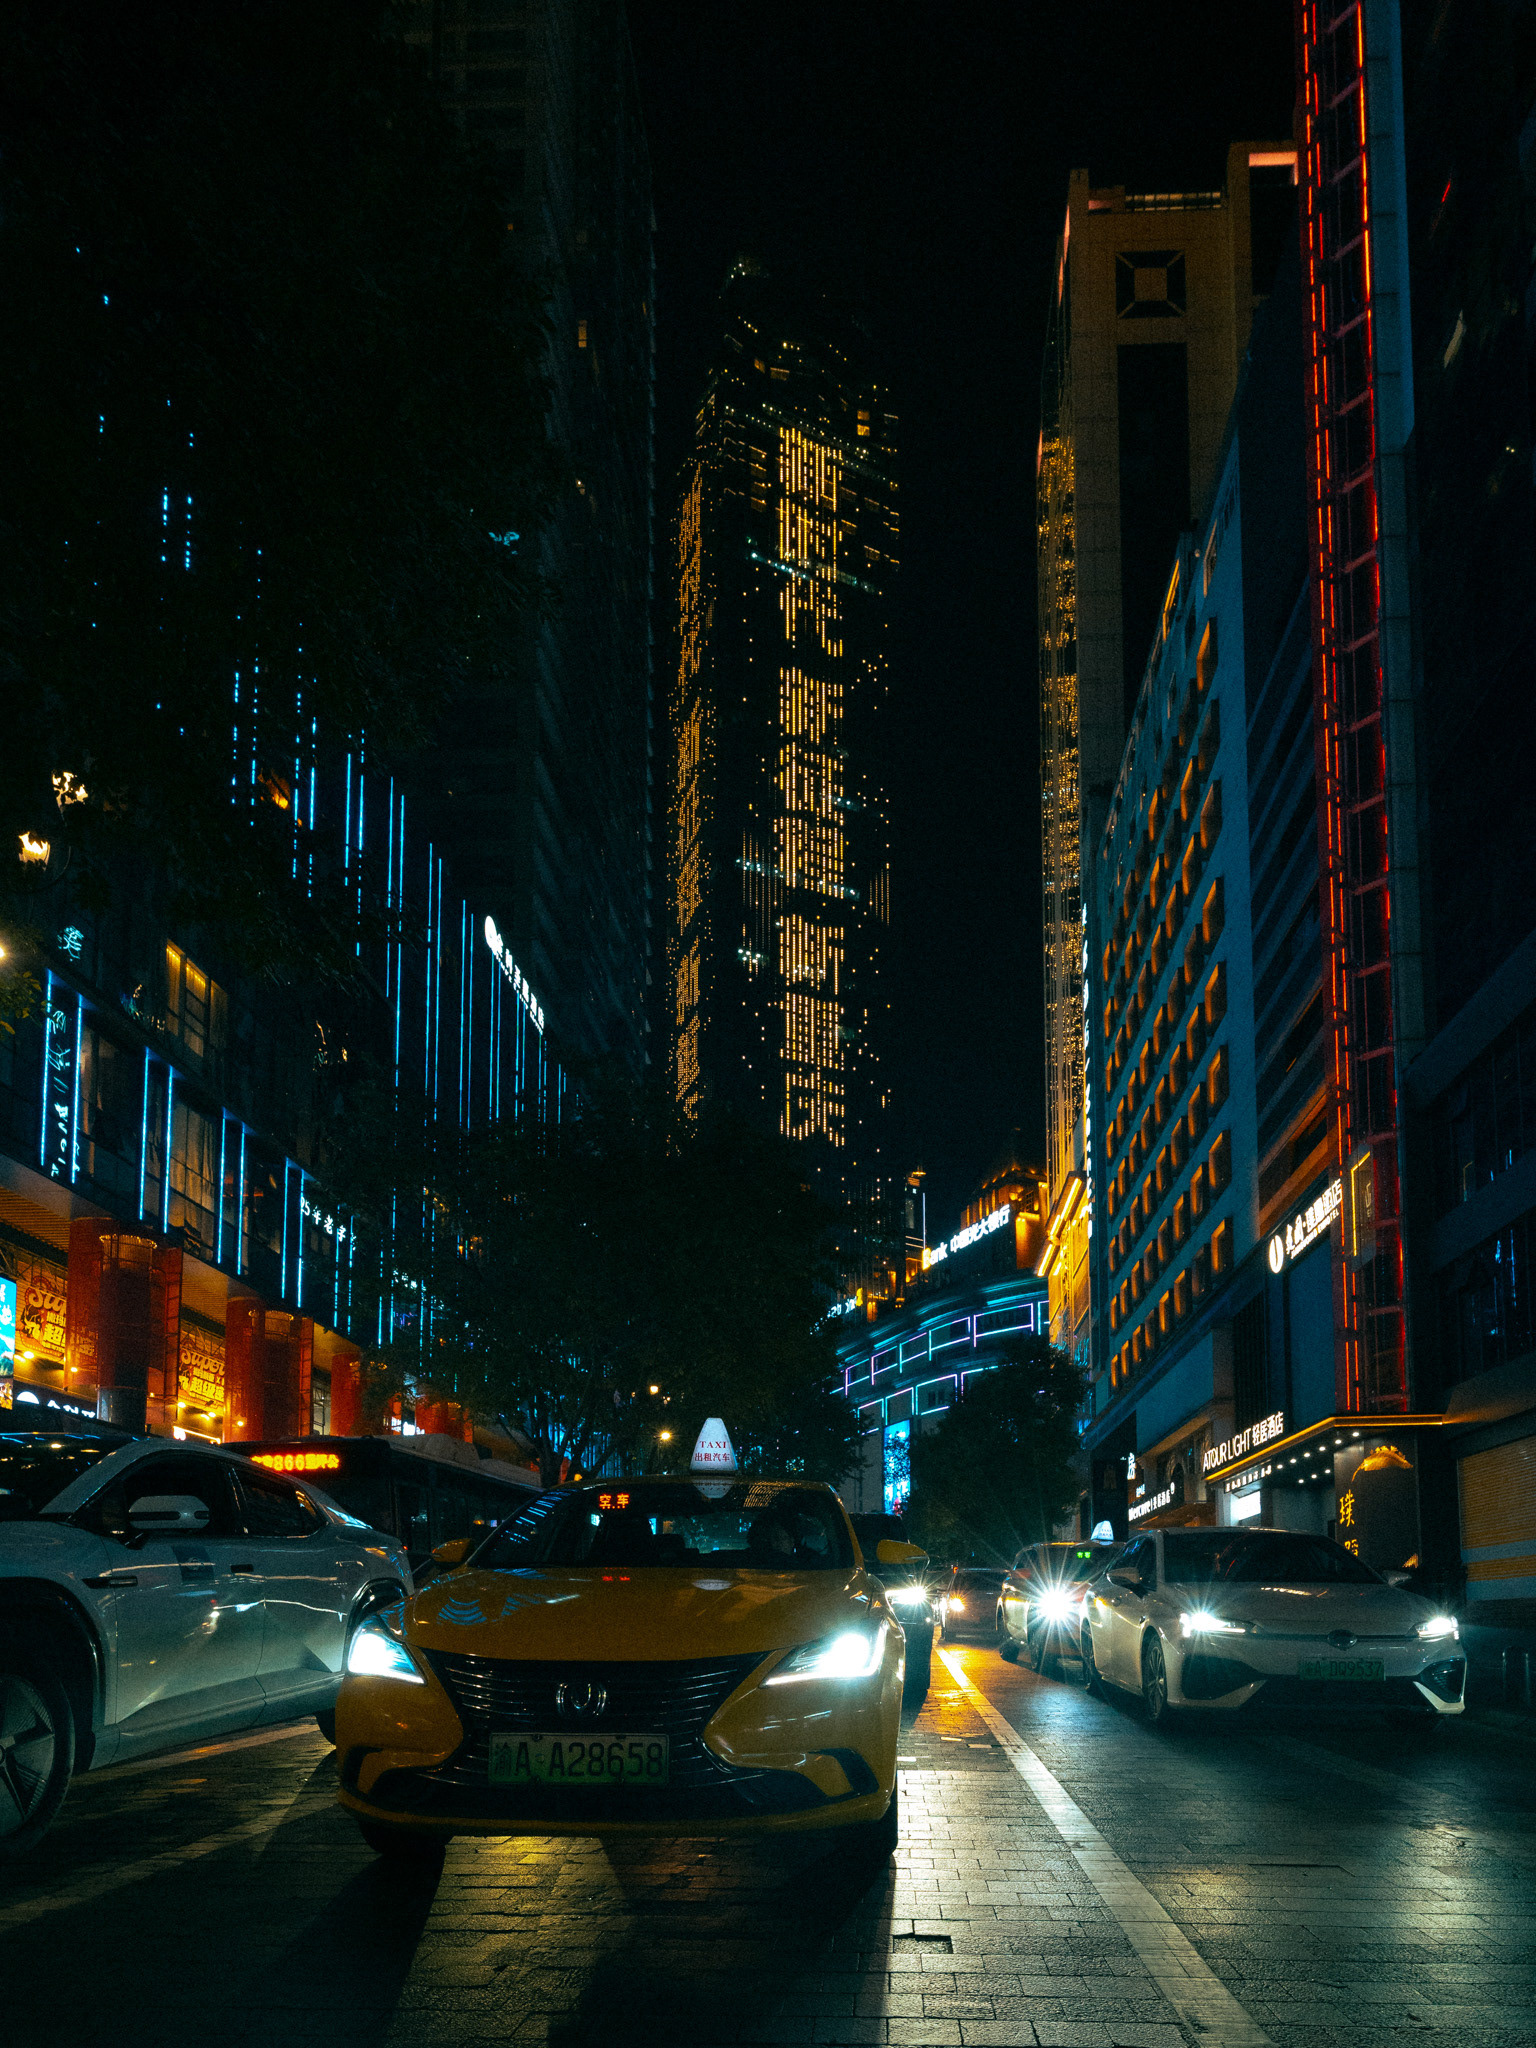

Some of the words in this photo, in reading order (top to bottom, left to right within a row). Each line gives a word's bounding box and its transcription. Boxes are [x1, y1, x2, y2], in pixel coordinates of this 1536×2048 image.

[779, 913, 846, 1148] 新重庆
[922, 1242, 949, 1271] Bank
[699, 1440, 727, 1449] TAXI
[1202, 1442, 1228, 1473] ATOUR
[1227, 1427, 1252, 1461] LIGHT
[1252, 1411, 1284, 1447] 轻居酒店
[694, 1452, 731, 1462] 出租汽车
[599, 1493, 630, 1508] 空车
[550, 1741, 664, 1778] A28658
